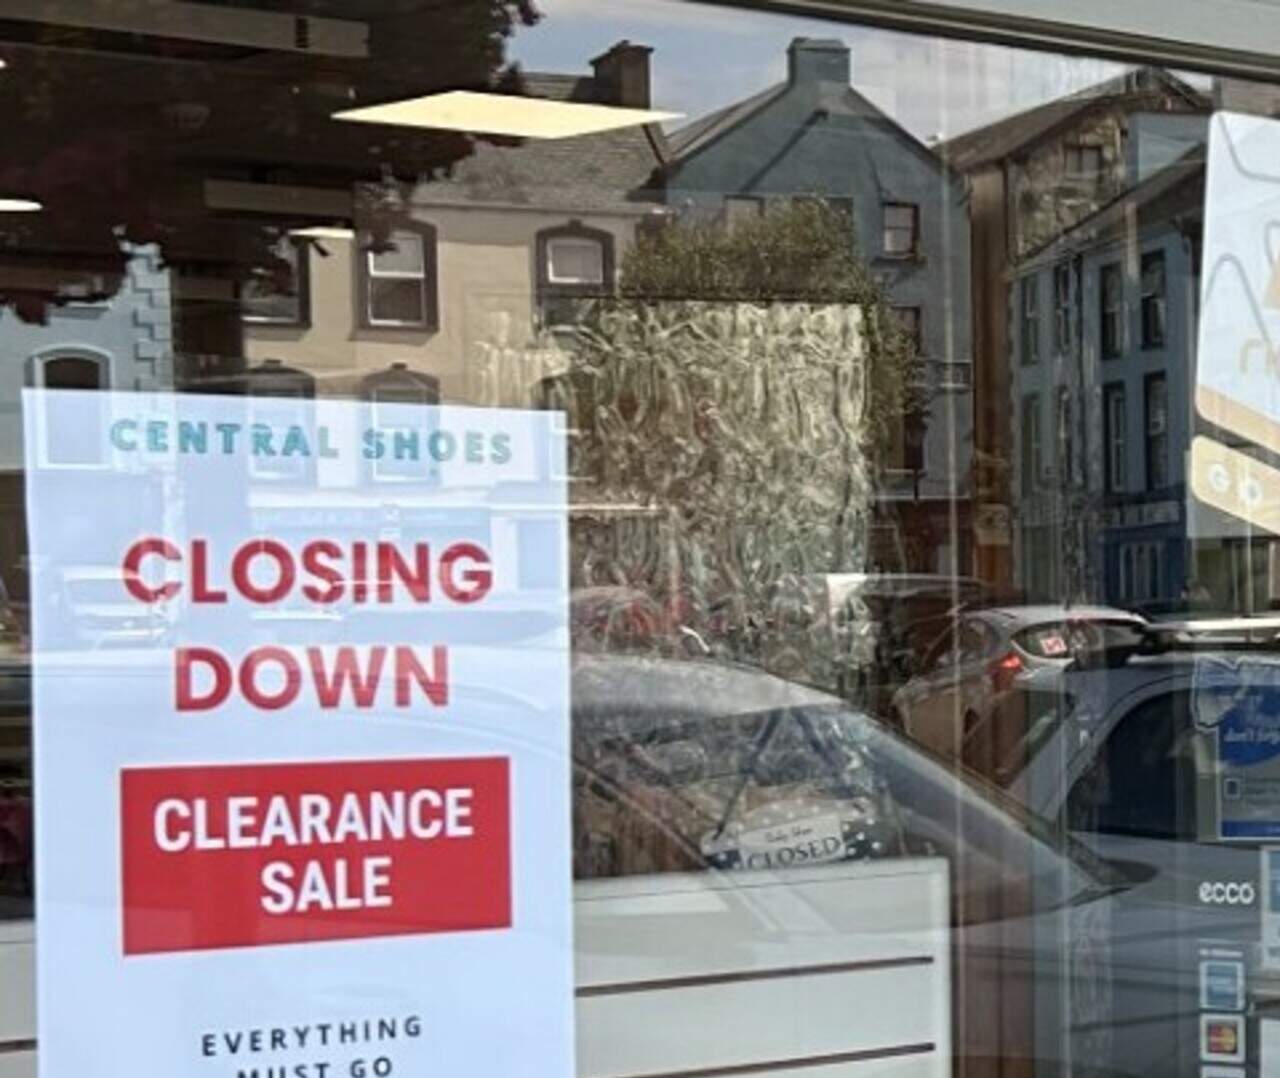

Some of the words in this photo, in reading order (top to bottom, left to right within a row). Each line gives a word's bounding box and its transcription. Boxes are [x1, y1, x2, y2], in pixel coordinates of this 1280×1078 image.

[110, 419, 339, 459] CENTRAL
[362, 425, 513, 465] SHOES
[1208, 463, 1263, 507] GO
[121, 536, 494, 604] CLOSING
[174, 645, 450, 711] DOWN
[153, 788, 474, 852] CLEARANCE
[746, 836, 841, 869] CLOSED
[260, 856, 393, 914] SALE
[1199, 881, 1255, 905] ecco
[201, 1015, 424, 1057] EVERYTHING
